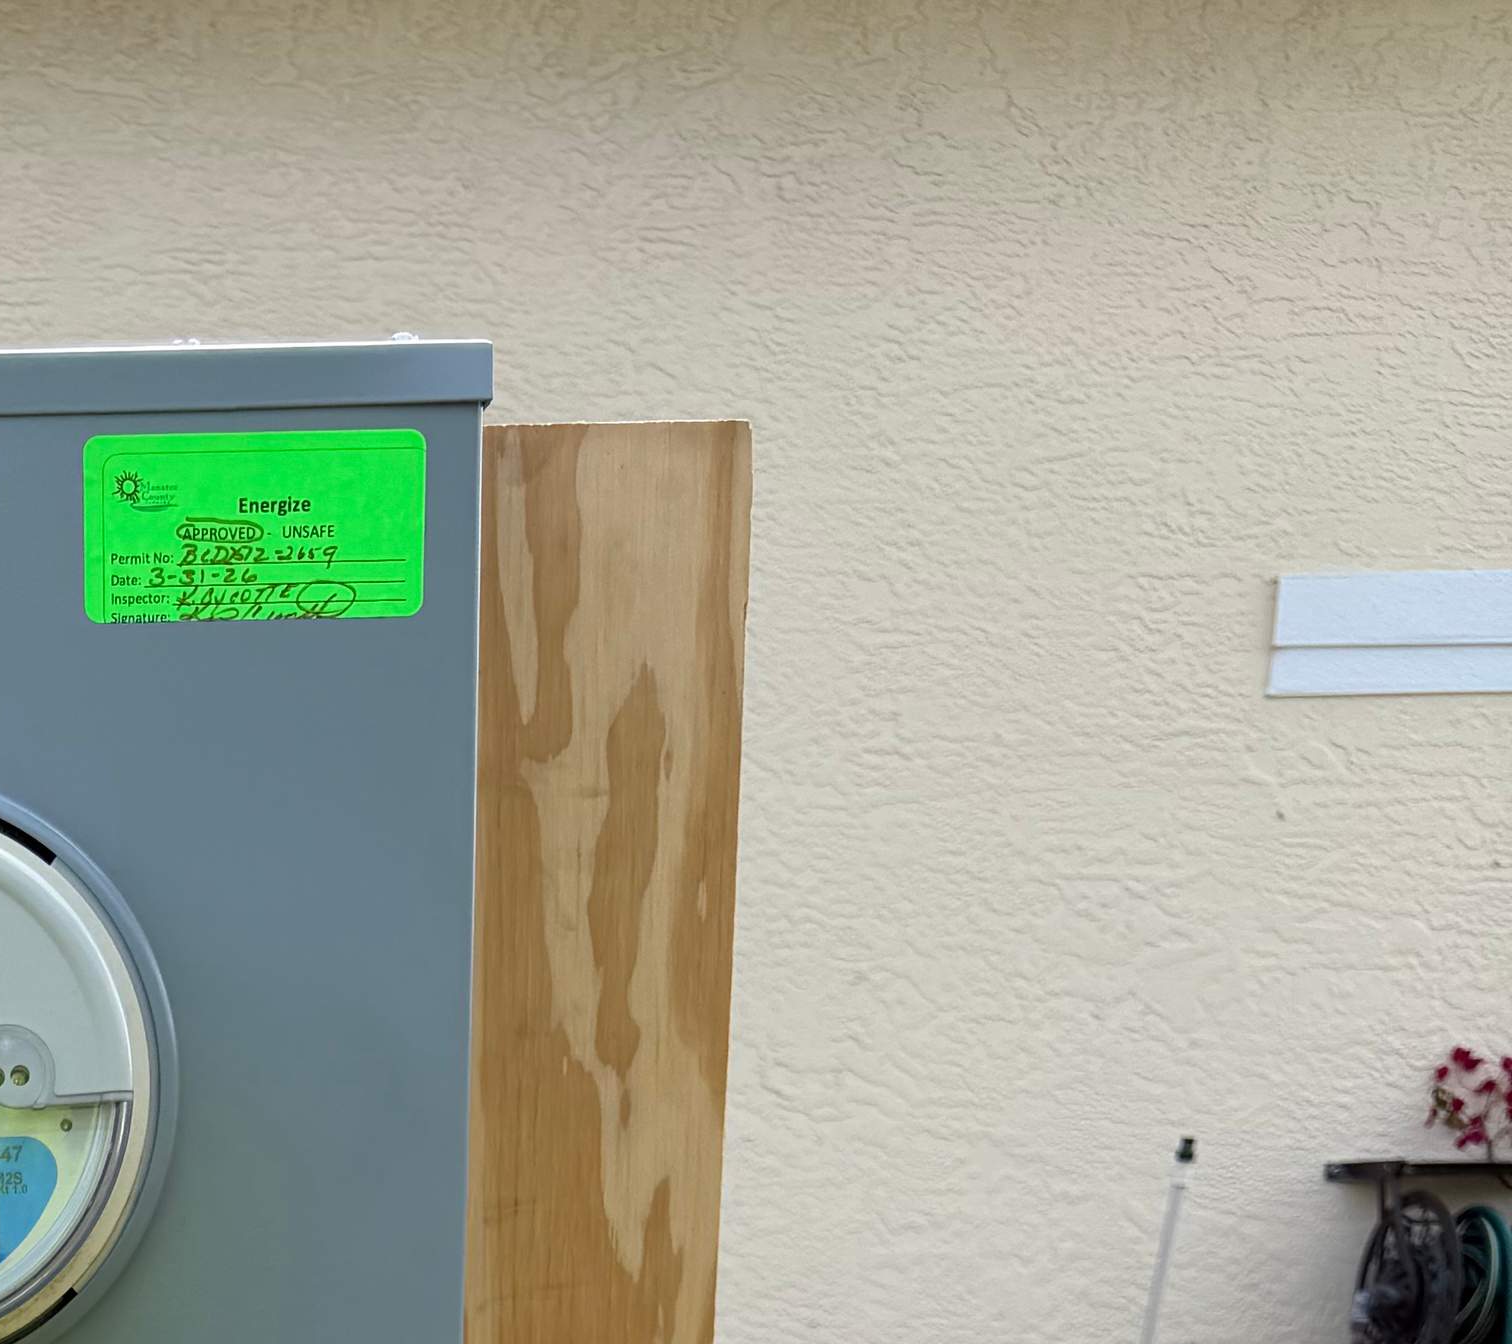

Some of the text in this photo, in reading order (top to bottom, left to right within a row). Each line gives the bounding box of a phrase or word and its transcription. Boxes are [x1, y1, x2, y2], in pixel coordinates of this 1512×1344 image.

[238, 496, 312, 516] Energize
[182, 526, 256, 541] APPROVED
[282, 525, 335, 539] UNSAFE
[111, 552, 174, 565] Permit No:
[111, 574, 142, 587] Date:
[148, 566, 258, 586] 3-31-26
[111, 593, 170, 607] Inspector:
[111, 612, 170, 624] Signature:
